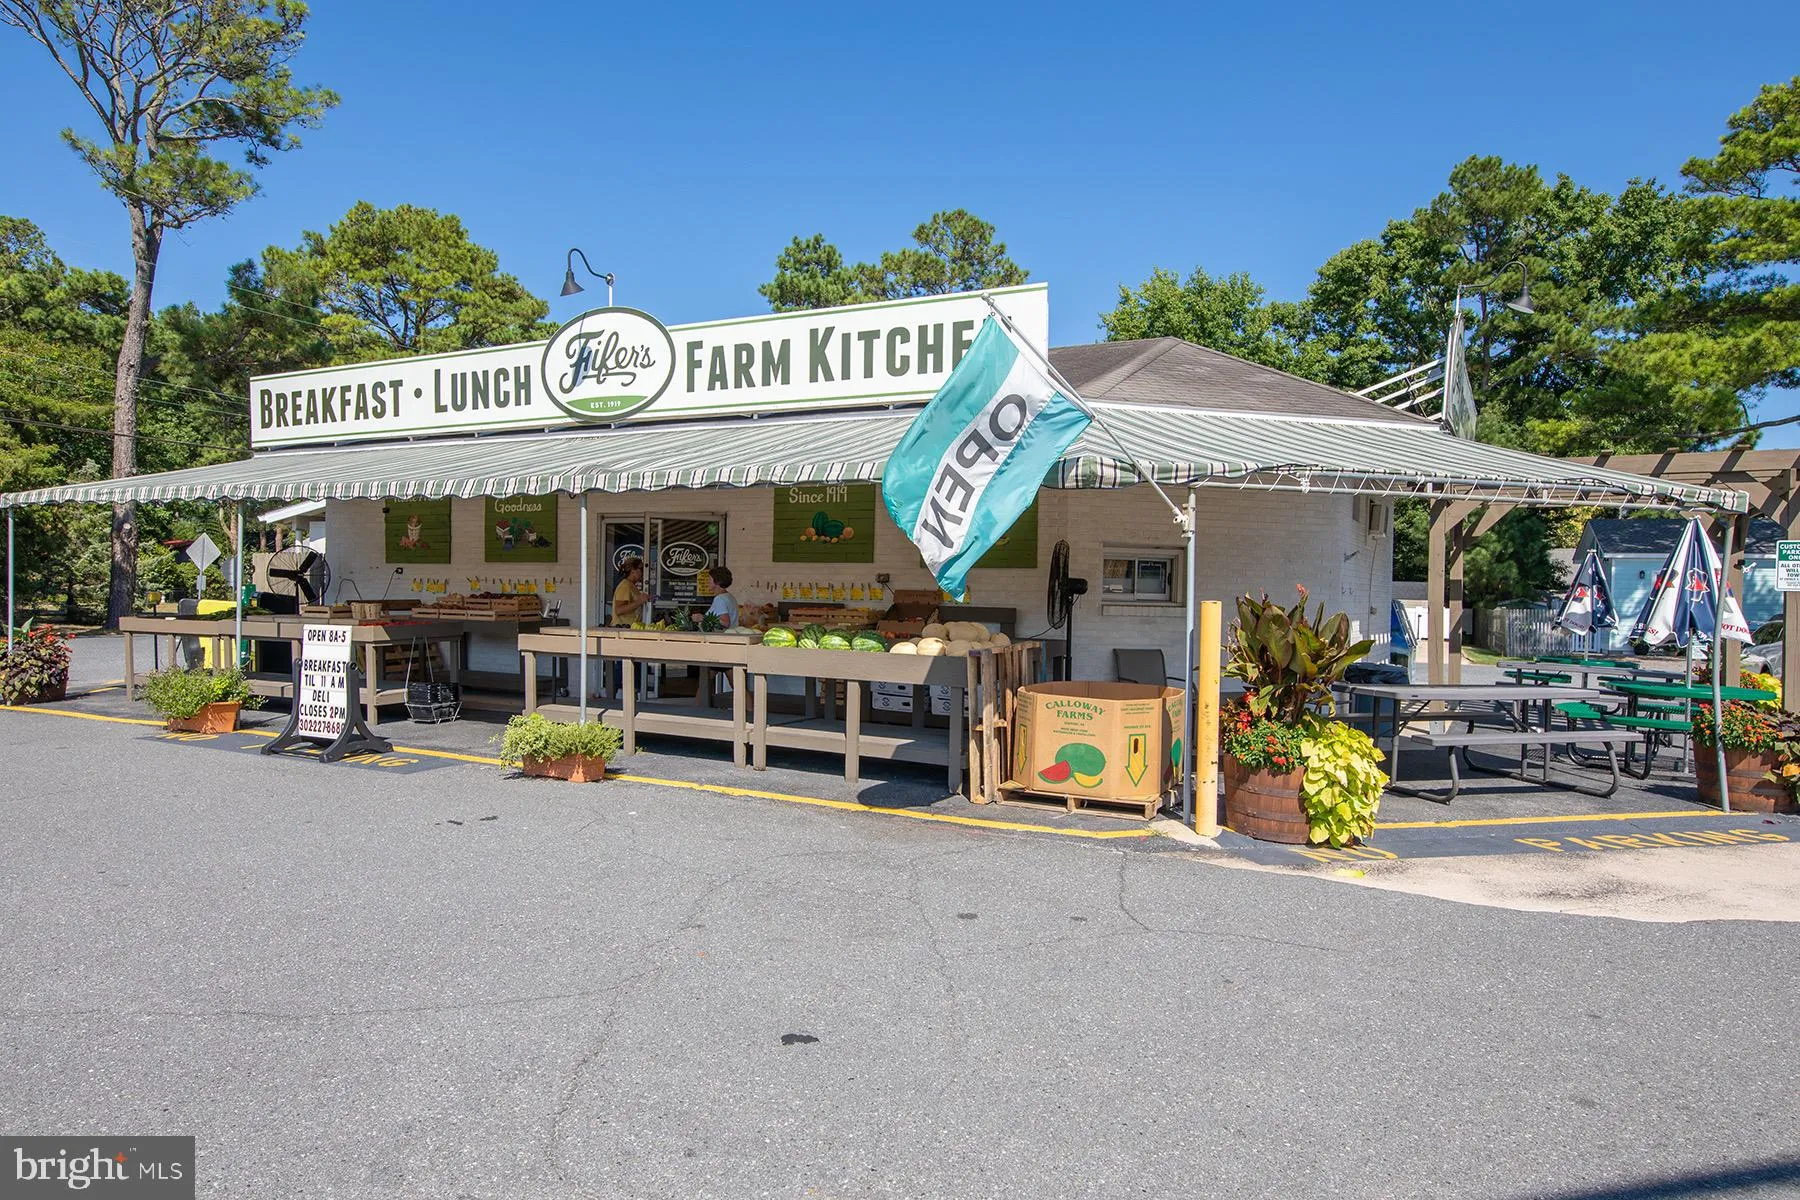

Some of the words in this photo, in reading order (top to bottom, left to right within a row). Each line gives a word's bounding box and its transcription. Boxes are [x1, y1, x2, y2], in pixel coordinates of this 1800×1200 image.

[686, 338, 791, 393] FARM
[808, 315, 1012, 384] KITCHE
[259, 379, 404, 429] BREAKFAST
[433, 364, 532, 413] LUNCH
[590, 401, 606, 409] EST.
[788, 486, 825, 504] Since
[826, 485, 848, 503] 1919
[494, 498, 543, 514] Goodness
[307, 629, 327, 643] OPEN
[328, 630, 347, 643] 8A-5
[303, 660, 347, 674] BREAKFAST
[304, 674, 316, 687] TIL
[312, 690, 330, 703] DELI
[299, 704, 328, 719] CLOSES
[329, 706, 346, 720] 2PM
[1045, 699, 1106, 716] CALLOWAY
[1056, 709, 1093, 721] FARMS
[1513, 829, 1792, 852] PARKING
